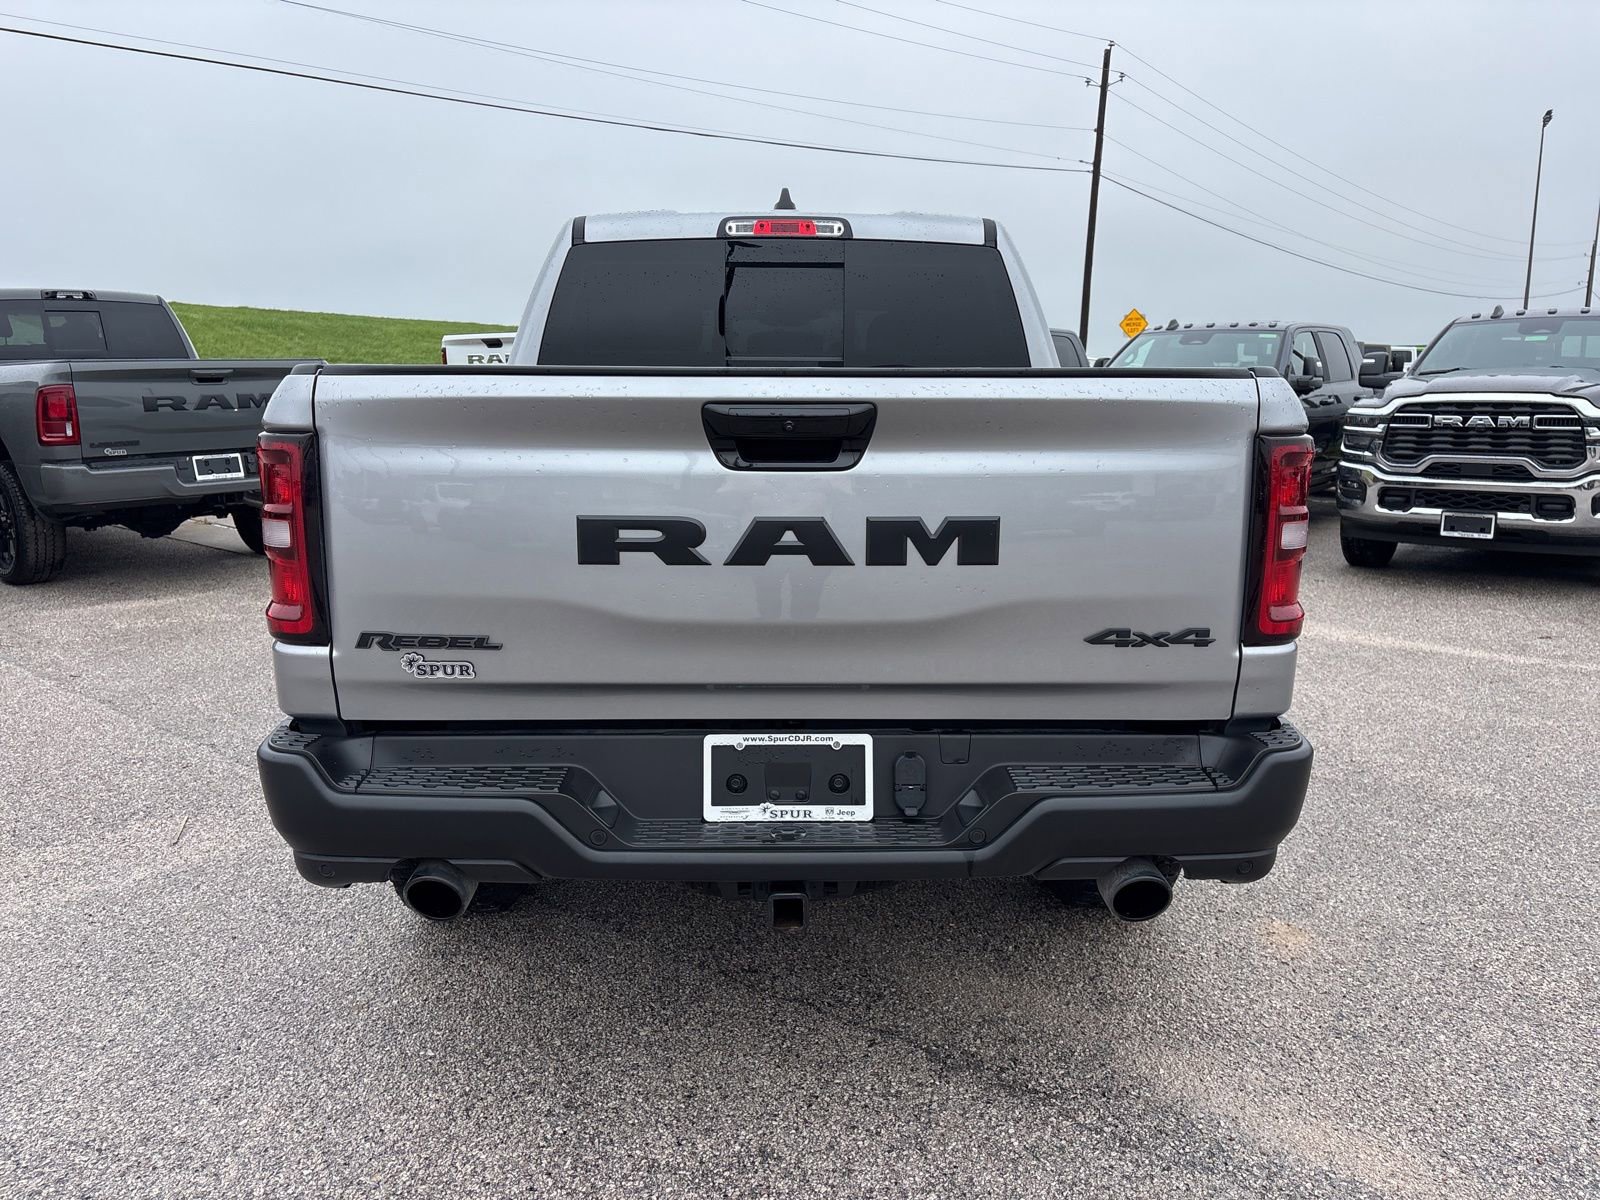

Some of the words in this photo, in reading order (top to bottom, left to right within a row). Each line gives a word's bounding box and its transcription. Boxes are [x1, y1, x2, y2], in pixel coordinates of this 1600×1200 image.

[467, 354, 510, 364] RA
[1433, 415, 1531, 428] RAM
[576, 515, 1001, 567] RAM
[354, 631, 503, 651] REBEL
[1083, 627, 1217, 648] 4x4
[416, 664, 472, 676] SPUR
[742, 735, 834, 743] www.SpurCDJR.com
[769, 809, 813, 819] SPUR
[836, 809, 856, 817] Jeep
